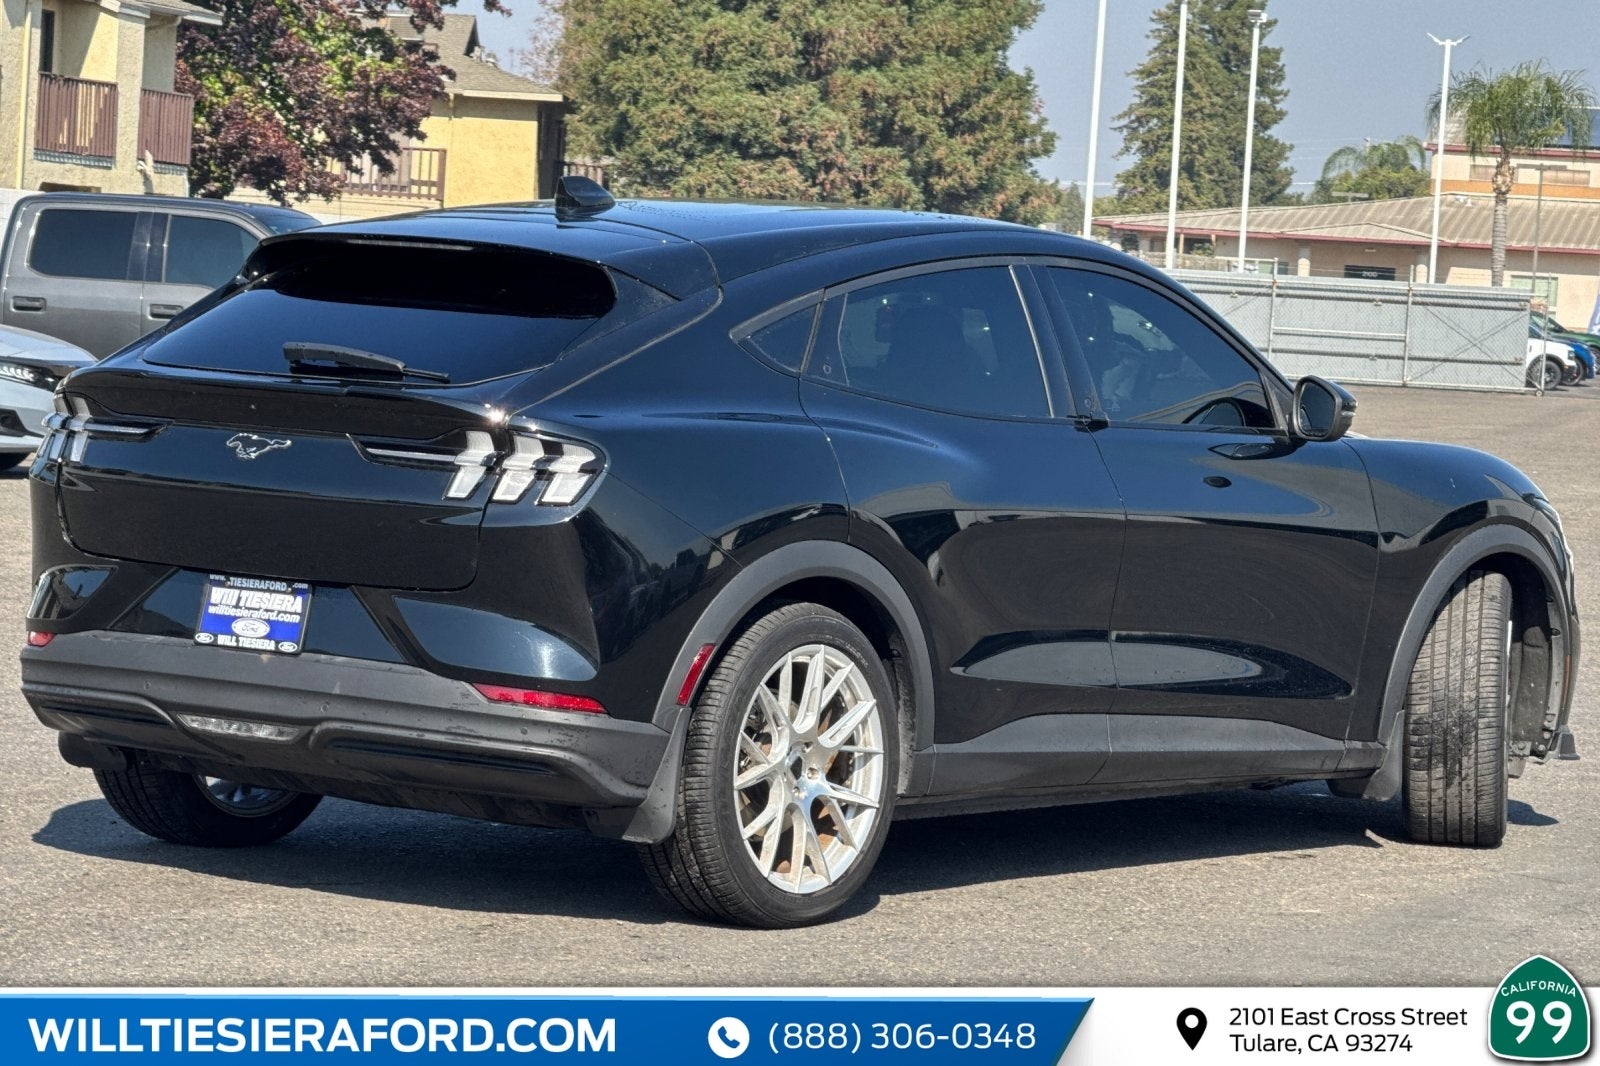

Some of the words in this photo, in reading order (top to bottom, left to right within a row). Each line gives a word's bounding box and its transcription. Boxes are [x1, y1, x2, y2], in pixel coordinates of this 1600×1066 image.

[229, 576, 287, 591] TIESIERAFORD
[238, 589, 304, 614] TIESIERA
[208, 604, 301, 624] willtiesieraford.com
[217, 634, 238, 647] WILL
[238, 636, 276, 651] TIESIERA
